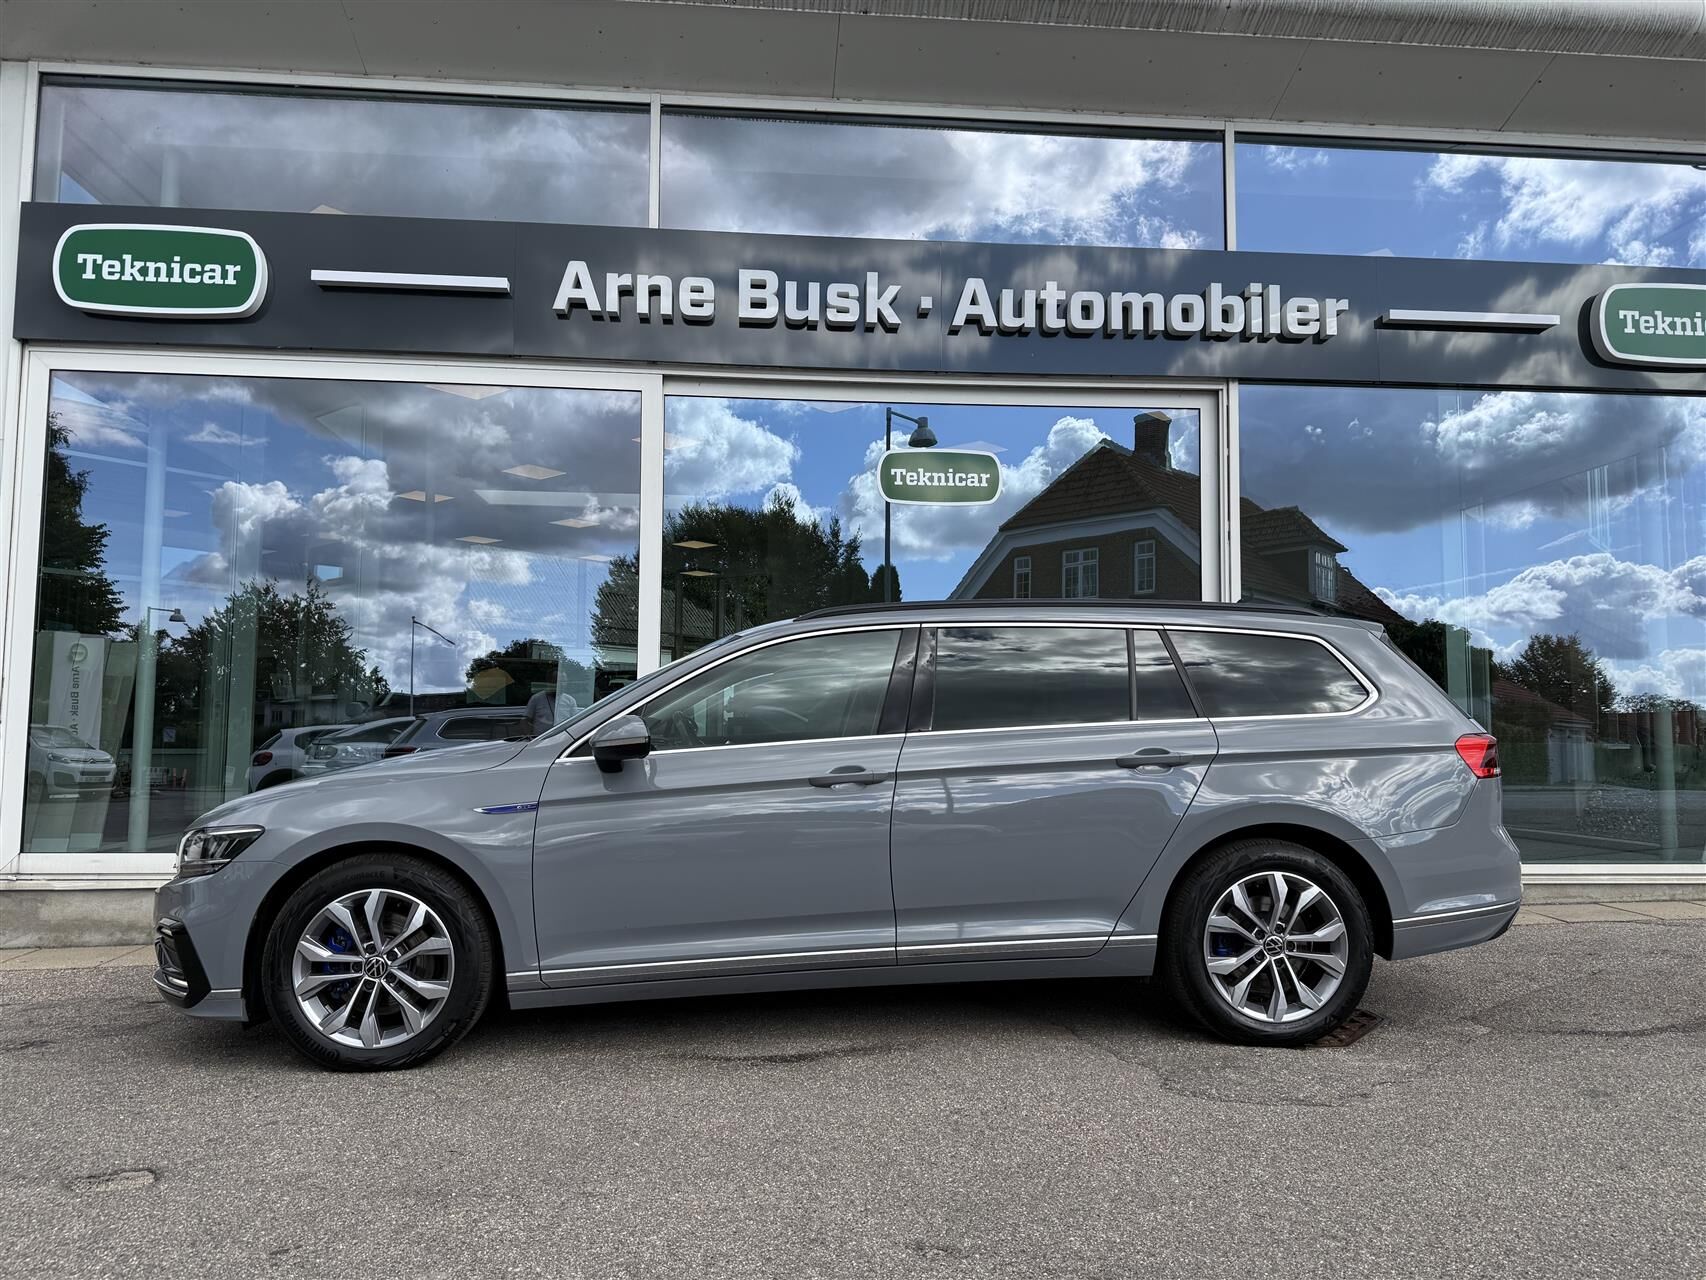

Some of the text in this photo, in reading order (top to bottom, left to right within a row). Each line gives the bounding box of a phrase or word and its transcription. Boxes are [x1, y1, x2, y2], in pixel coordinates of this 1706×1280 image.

[77, 253, 241, 285] Teknicar
[552, 260, 716, 323] Arne
[738, 268, 902, 331] Busk
[950, 277, 1349, 338] Automobiler
[1619, 309, 1706, 336] Tekni
[890, 468, 991, 487] Teknicar
